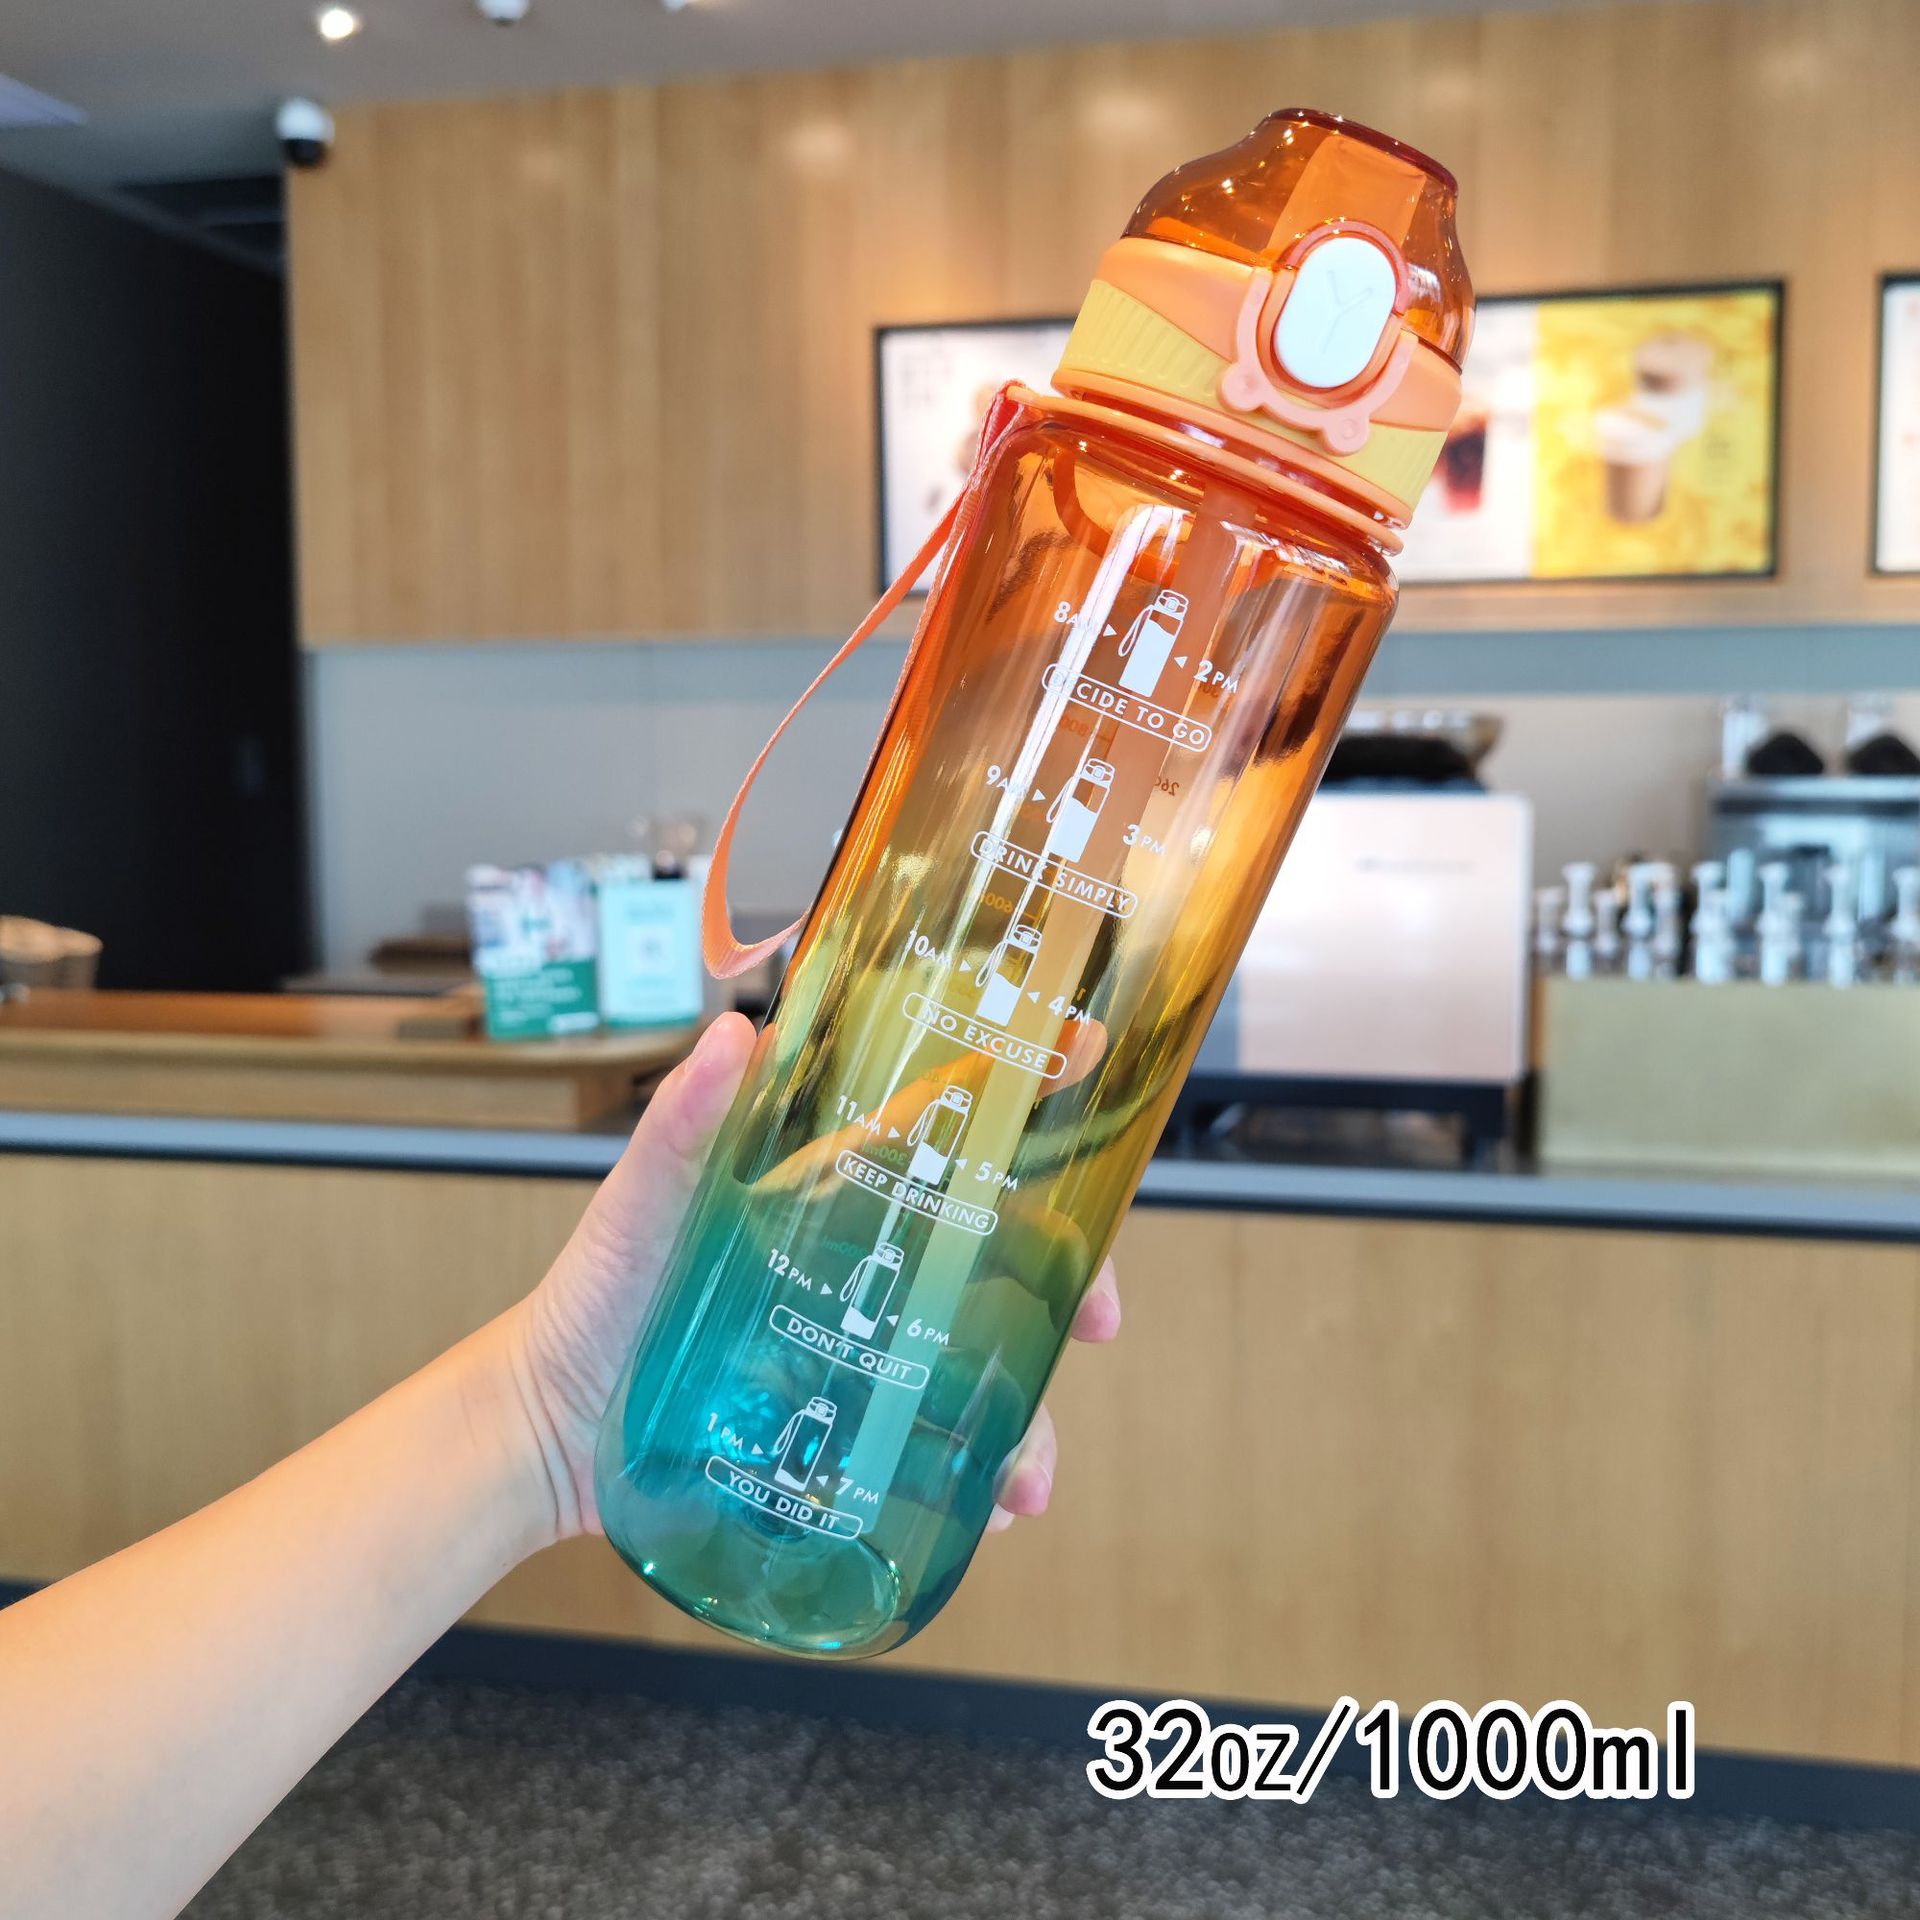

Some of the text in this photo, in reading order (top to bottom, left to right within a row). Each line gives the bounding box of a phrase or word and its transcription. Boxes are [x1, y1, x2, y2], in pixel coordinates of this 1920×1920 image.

[1054, 601, 1097, 634] 8A
[1136, 706, 1165, 729] TO
[1173, 723, 1206, 746] GO
[986, 764, 1023, 795] 9A
[979, 838, 1131, 912] DRINK SIMPLY
[925, 1005, 1048, 1069] NO EXCUSE
[843, 1157, 990, 1230] KEEP DRINKING
[786, 1317, 913, 1380] DON'T QUIT
[728, 1471, 840, 1530] YOU DID IT
